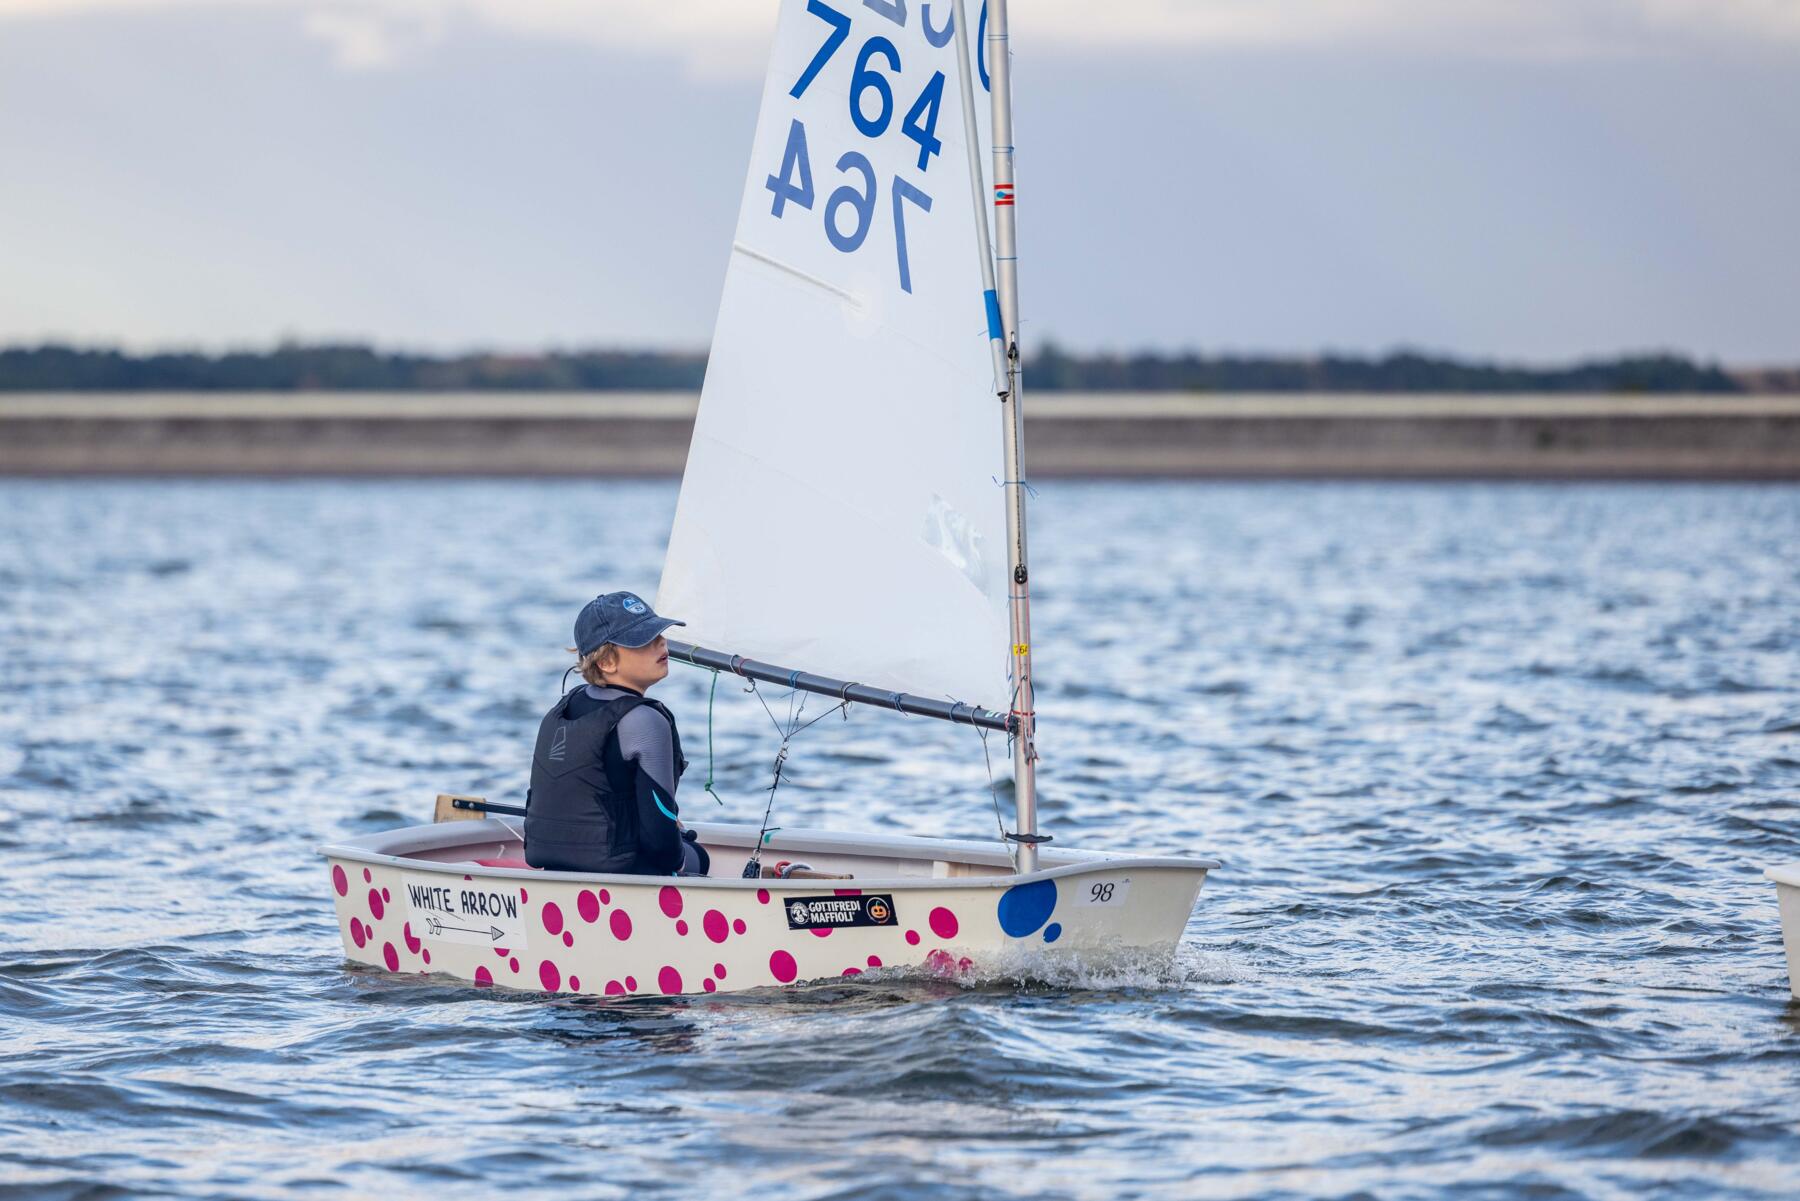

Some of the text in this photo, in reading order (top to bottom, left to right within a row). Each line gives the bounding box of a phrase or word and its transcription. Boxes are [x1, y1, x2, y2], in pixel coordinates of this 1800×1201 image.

[789, 0, 945, 172] 764
[407, 883, 517, 919] WHITE ARROW
[808, 900, 861, 912] GOTTIFREDI
[1090, 882, 1115, 903] 98
